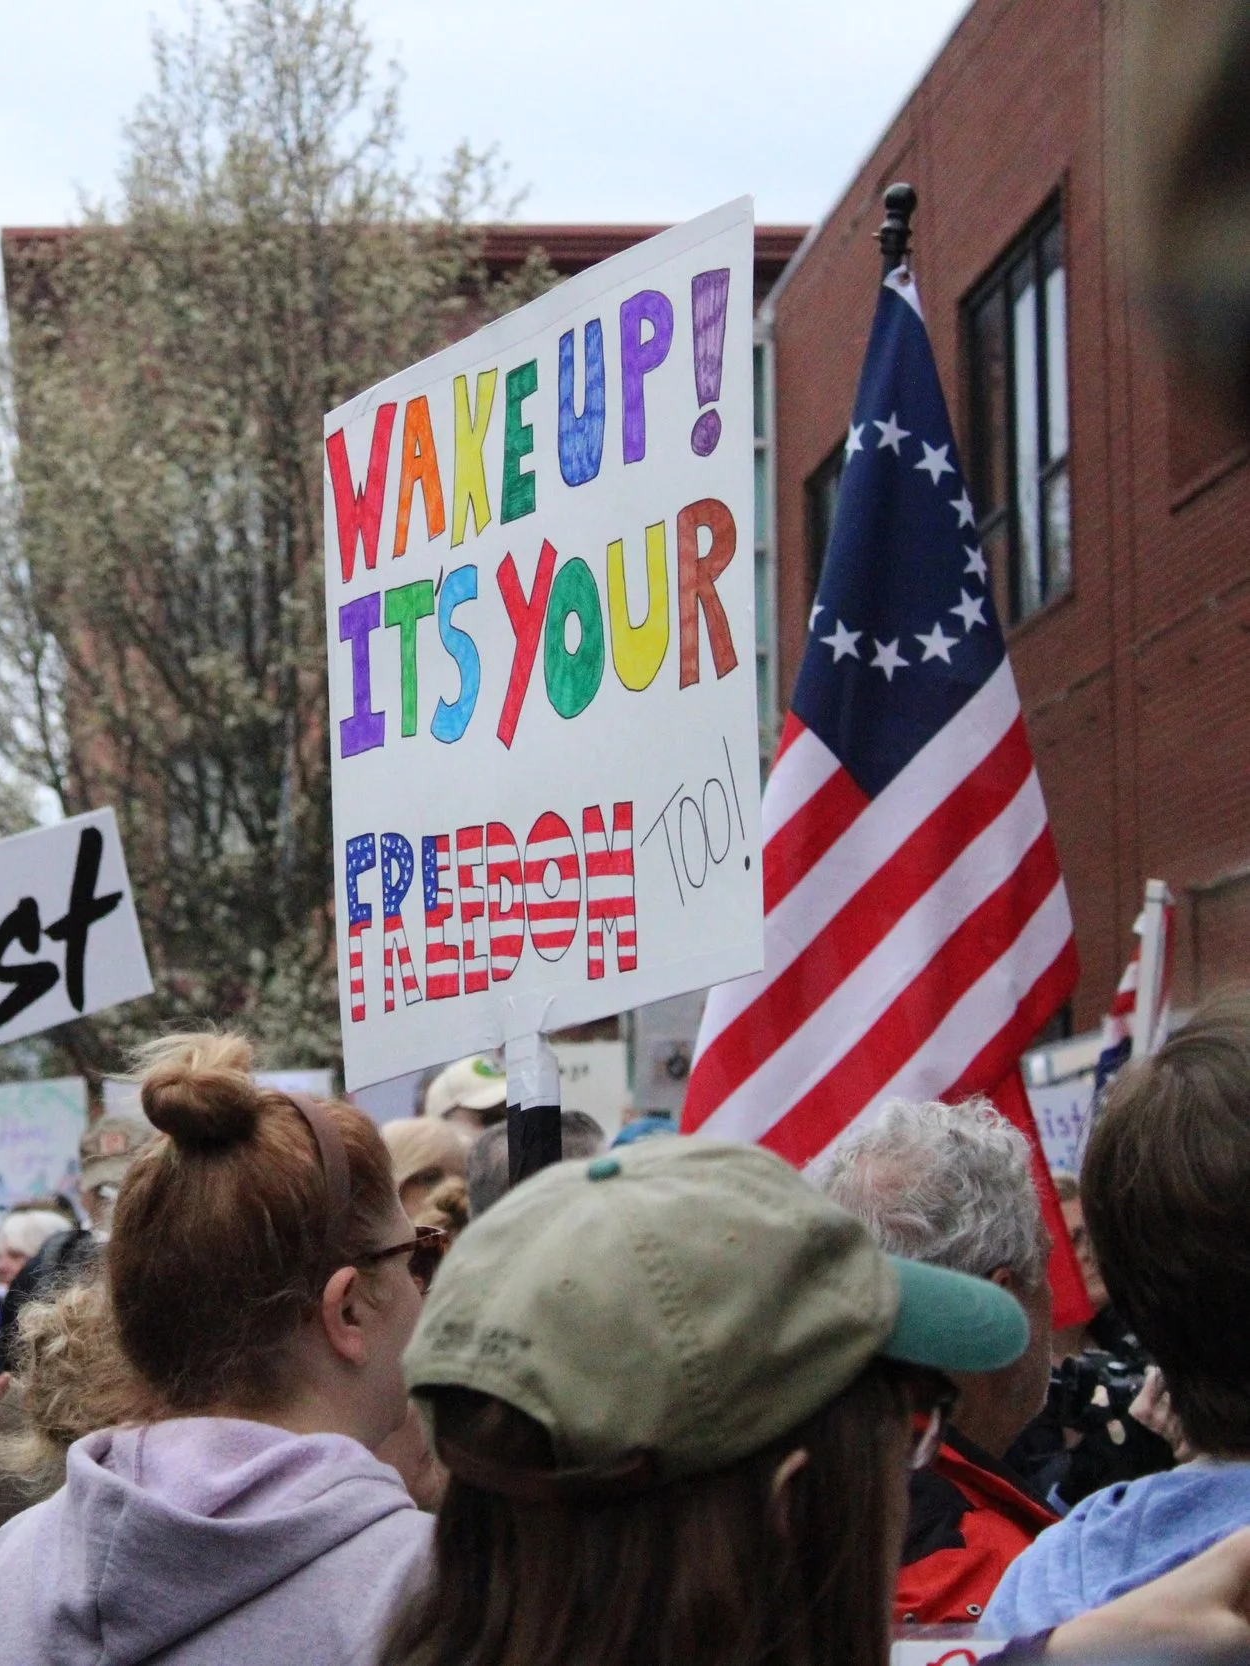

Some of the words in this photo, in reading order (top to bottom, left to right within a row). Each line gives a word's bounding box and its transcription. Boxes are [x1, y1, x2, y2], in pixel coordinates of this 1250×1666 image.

[326, 358, 538, 584] WAKE
[558, 267, 731, 487] UP!
[339, 564, 481, 759] IT'S
[496, 497, 739, 750] YOUR
[345, 801, 638, 1022] FREEDOM
[640, 736, 752, 907] TOO!
